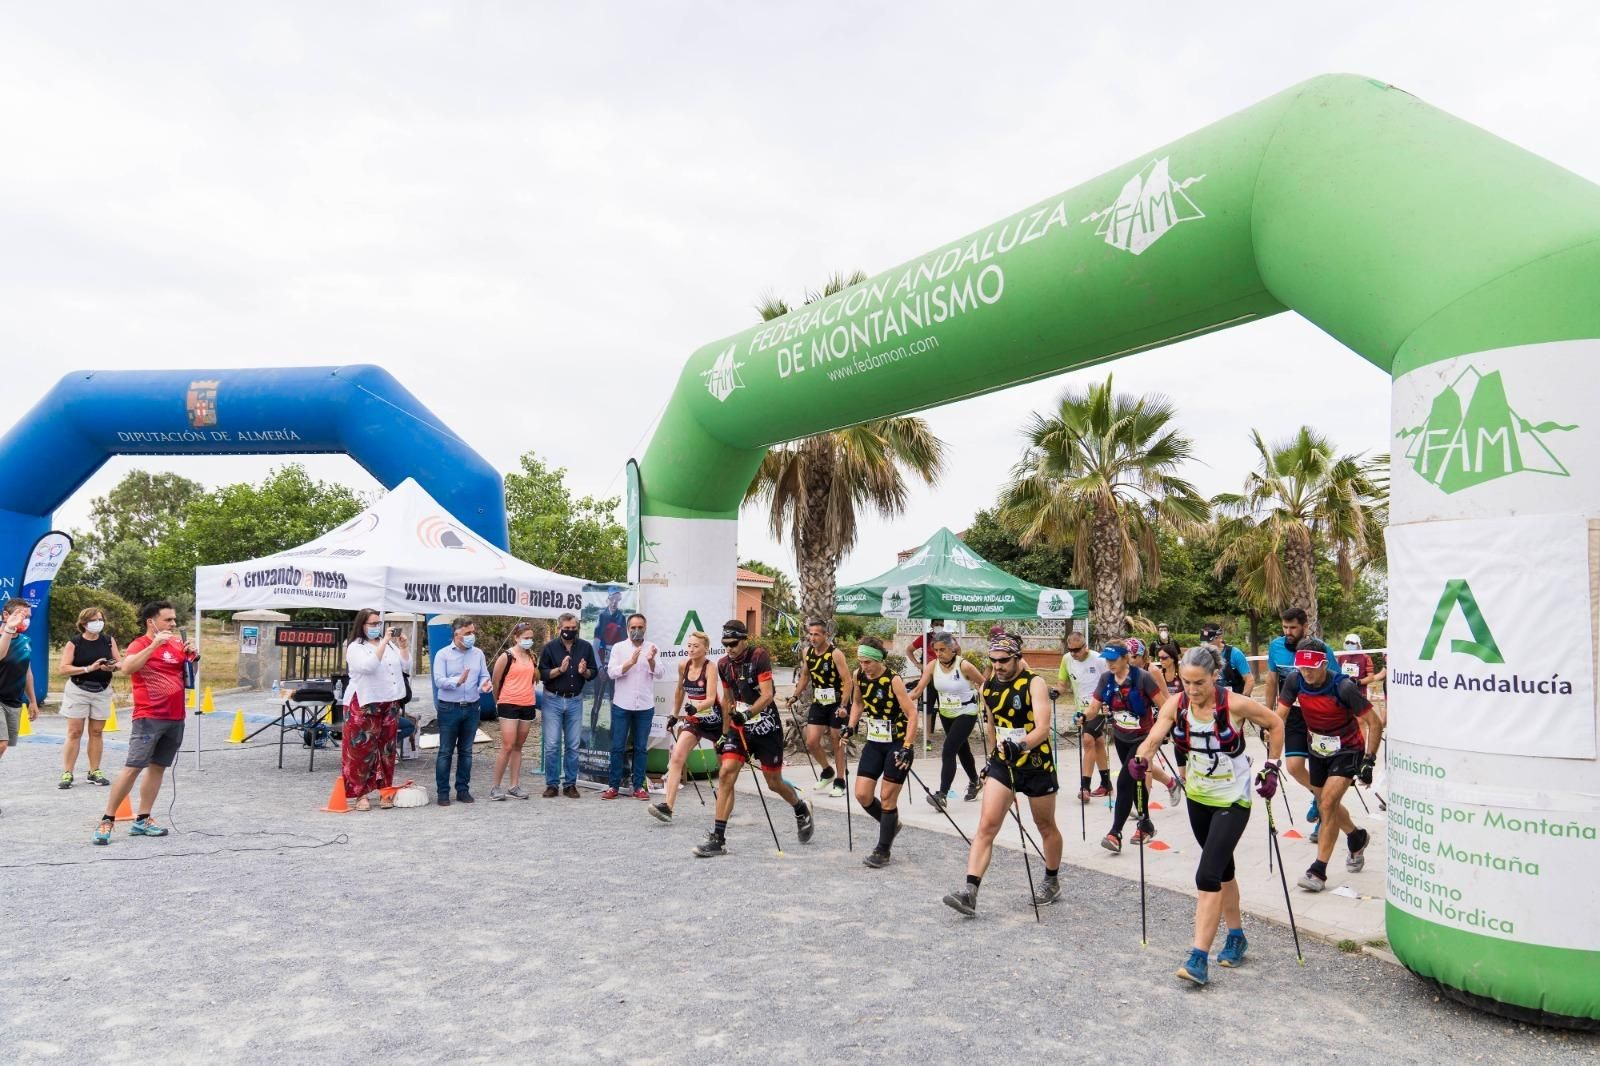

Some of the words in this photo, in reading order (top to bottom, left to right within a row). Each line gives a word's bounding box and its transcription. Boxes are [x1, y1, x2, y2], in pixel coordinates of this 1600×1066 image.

[749, 276, 891, 356] FEDERACION
[892, 200, 1068, 298] ANDALUZA
[777, 341, 806, 379] DE
[811, 264, 1004, 368] MONTAÑISMO
[826, 335, 940, 382] www.fedamon.com
[117, 430, 206, 442] DIPUTACIÓN
[211, 431, 232, 441] DE
[238, 428, 301, 441] ALMERÍA
[1421, 426, 1513, 486] FAM
[404, 583, 582, 610] www.cruzandolameta.es
[952, 604, 962, 612] DE
[1391, 668, 1423, 687] Junta
[1427, 671, 1449, 689] de
[1454, 673, 1573, 695] Andalucía
[1441, 807, 1476, 824] por
[1483, 810, 1597, 840] Montaña
[1412, 834, 1431, 853] de
[1437, 840, 1539, 875] Montaña
[1429, 896, 1514, 934] Nórdica
